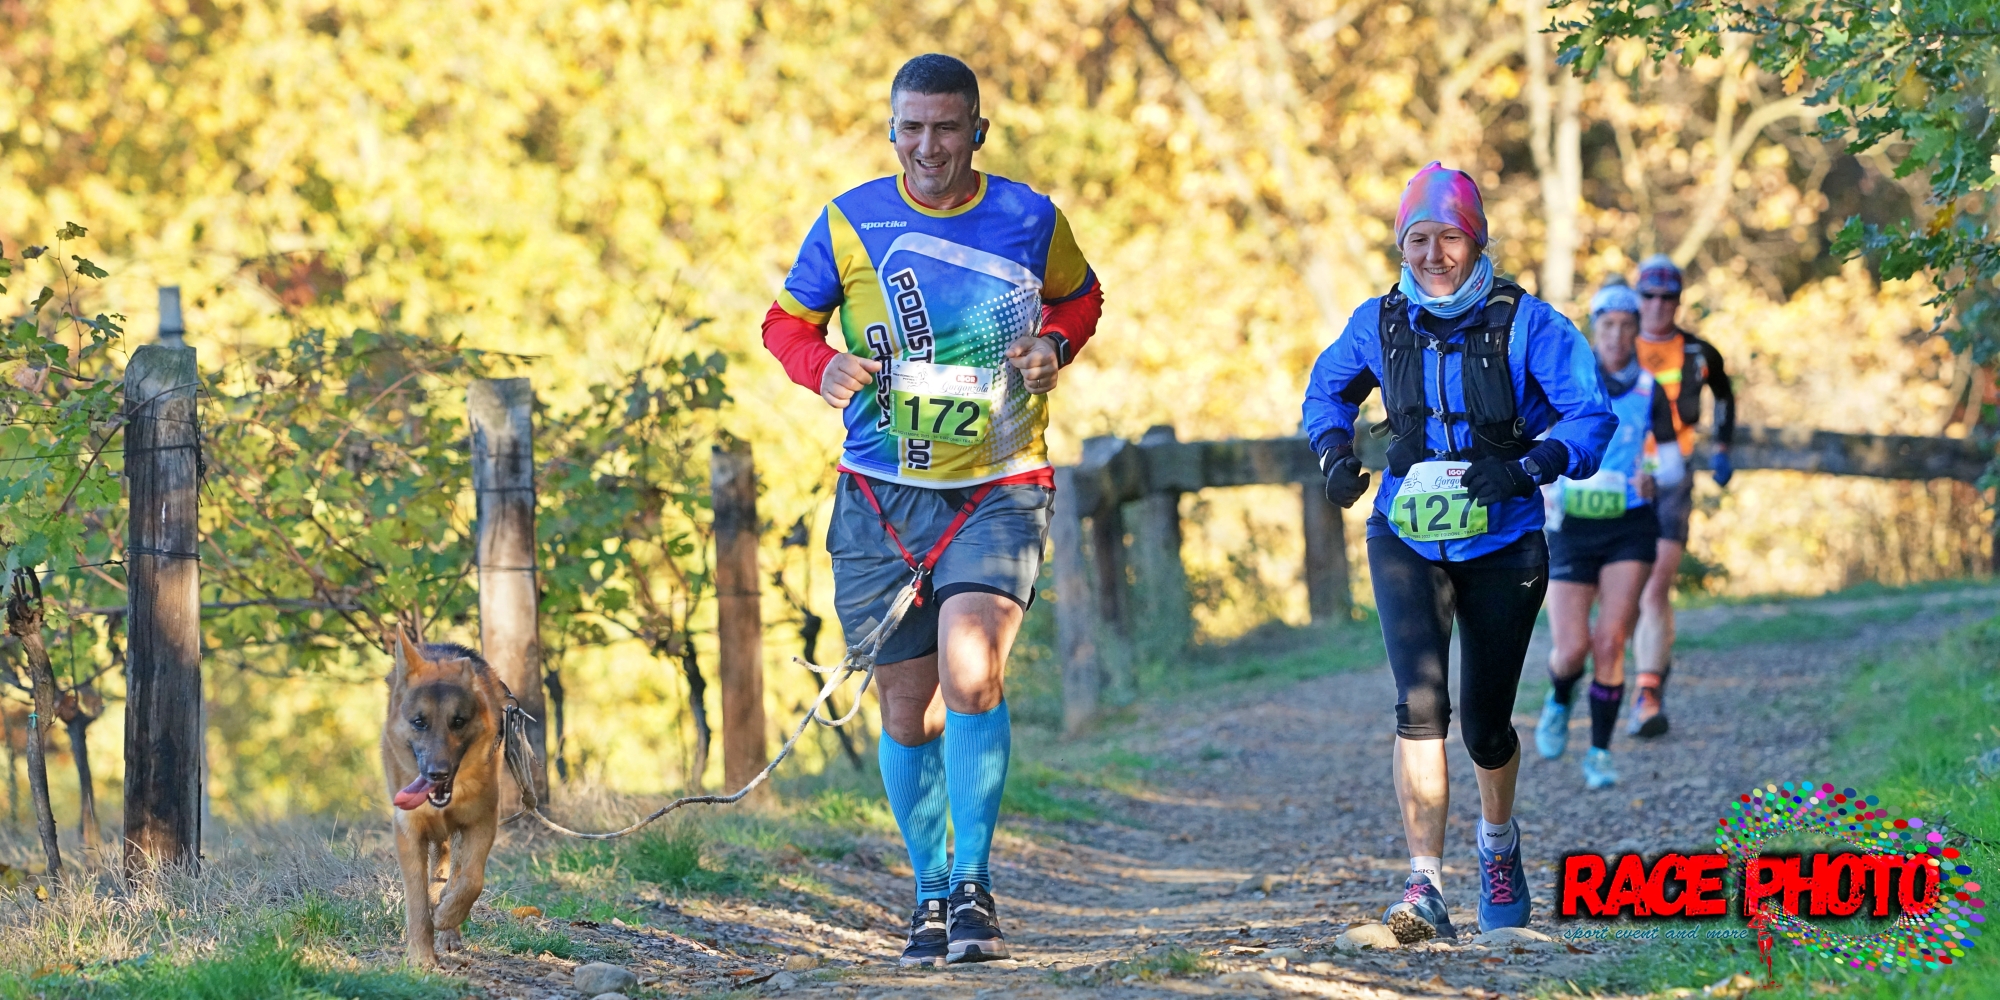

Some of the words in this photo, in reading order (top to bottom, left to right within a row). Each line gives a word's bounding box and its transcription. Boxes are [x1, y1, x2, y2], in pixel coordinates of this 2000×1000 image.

[861, 221, 907, 230] sportika
[942, 383, 989, 394] Gorgonzola
[904, 396, 980, 437] 172
[1434, 476, 1460, 489] Gorgo
[1402, 492, 1474, 533] 127
